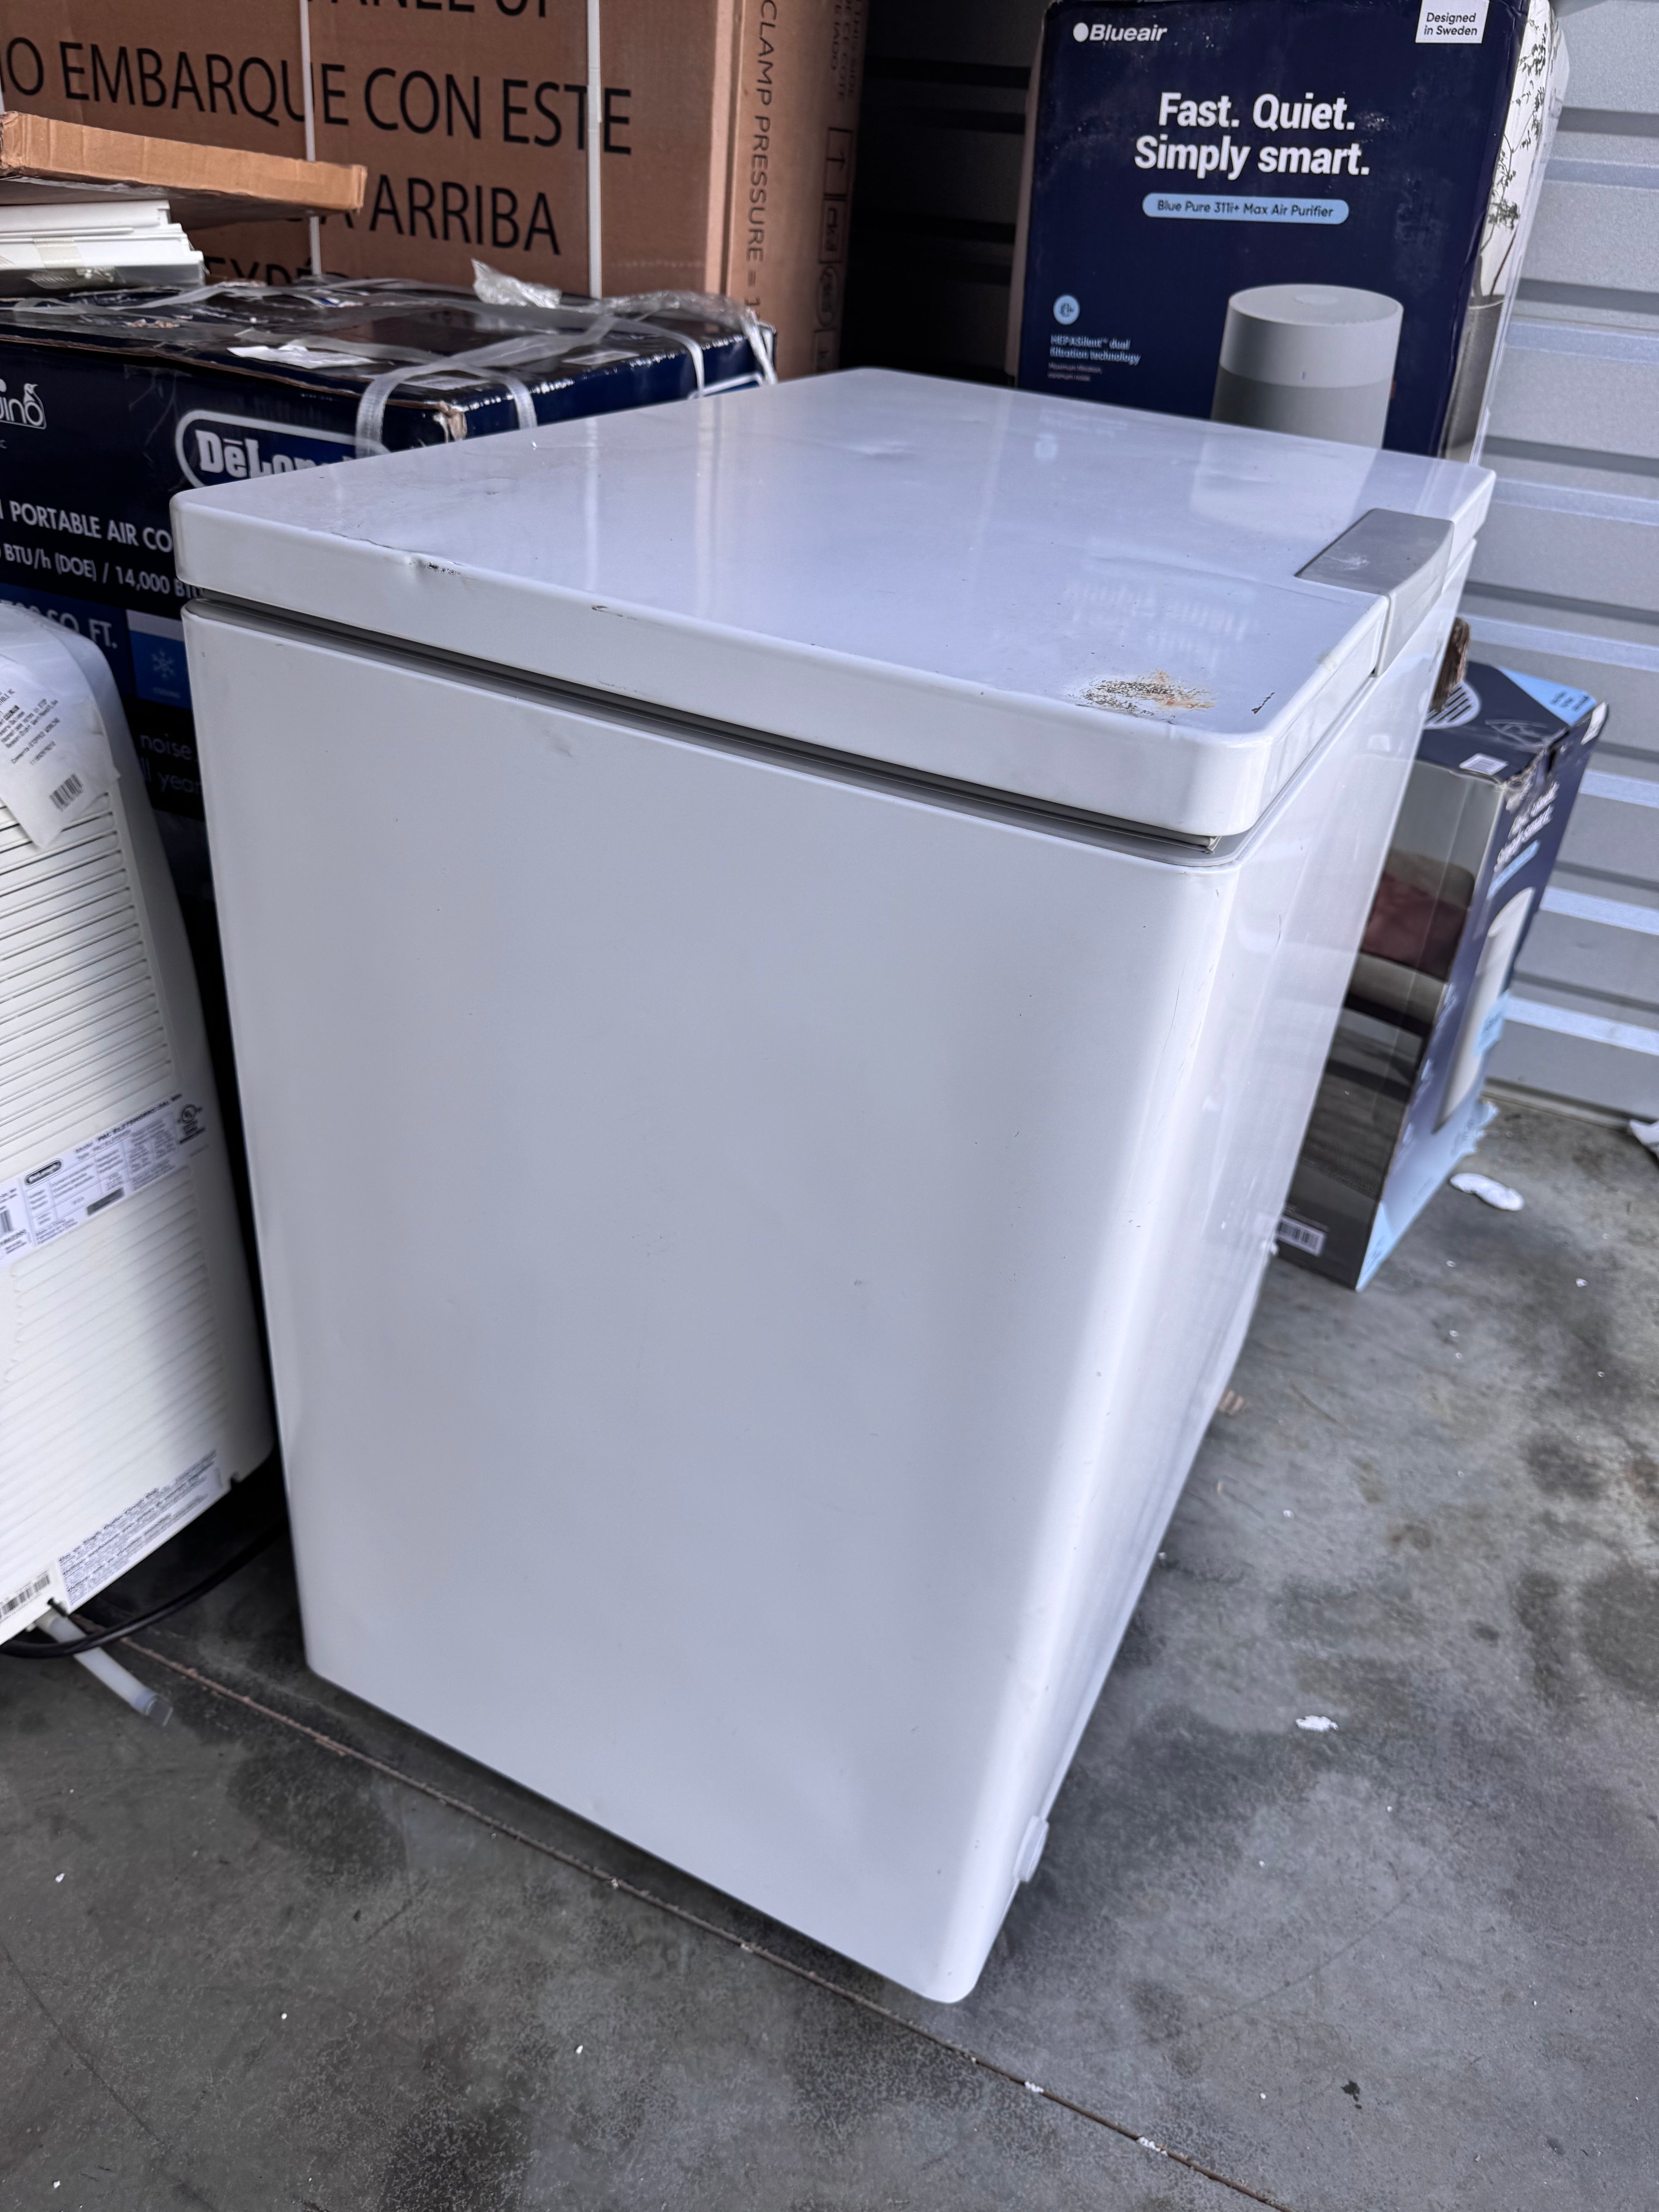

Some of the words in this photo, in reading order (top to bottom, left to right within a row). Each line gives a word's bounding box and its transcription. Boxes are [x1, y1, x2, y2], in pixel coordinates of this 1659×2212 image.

[1089, 24, 1167, 42] Blueair
[1424, 25, 1433, 35] in
[1436, 25, 1478, 36] Sweden
[1426, 12, 1476, 25] Designed
[755, 0, 777, 106] CLAMP
[0, 37, 44, 96] O
[60, 41, 349, 126] EMBARQUE
[365, 67, 481, 140] CON
[503, 78, 632, 155] ESTE
[1158, 92, 1239, 127] Fast.
[1253, 92, 1355, 132] Quiet.
[1134, 134, 1251, 180] Simply
[1258, 142, 1370, 175] smart.
[746, 115, 771, 263] PRESSURE
[1157, 199, 1182, 212] Blue
[1185, 200, 1211, 213] Pure
[1243, 203, 1268, 215] Max
[1272, 204, 1288, 216] Air
[1291, 204, 1333, 217] Purifier
[369, 174, 561, 255] ARRIBA
[9, 500, 102, 539] PORTABLE
[107, 519, 140, 547] AIR
[3, 543, 52, 570] BTU/h
[54, 552, 97, 582] (DOE)
[115, 566, 171, 594] 14,000
